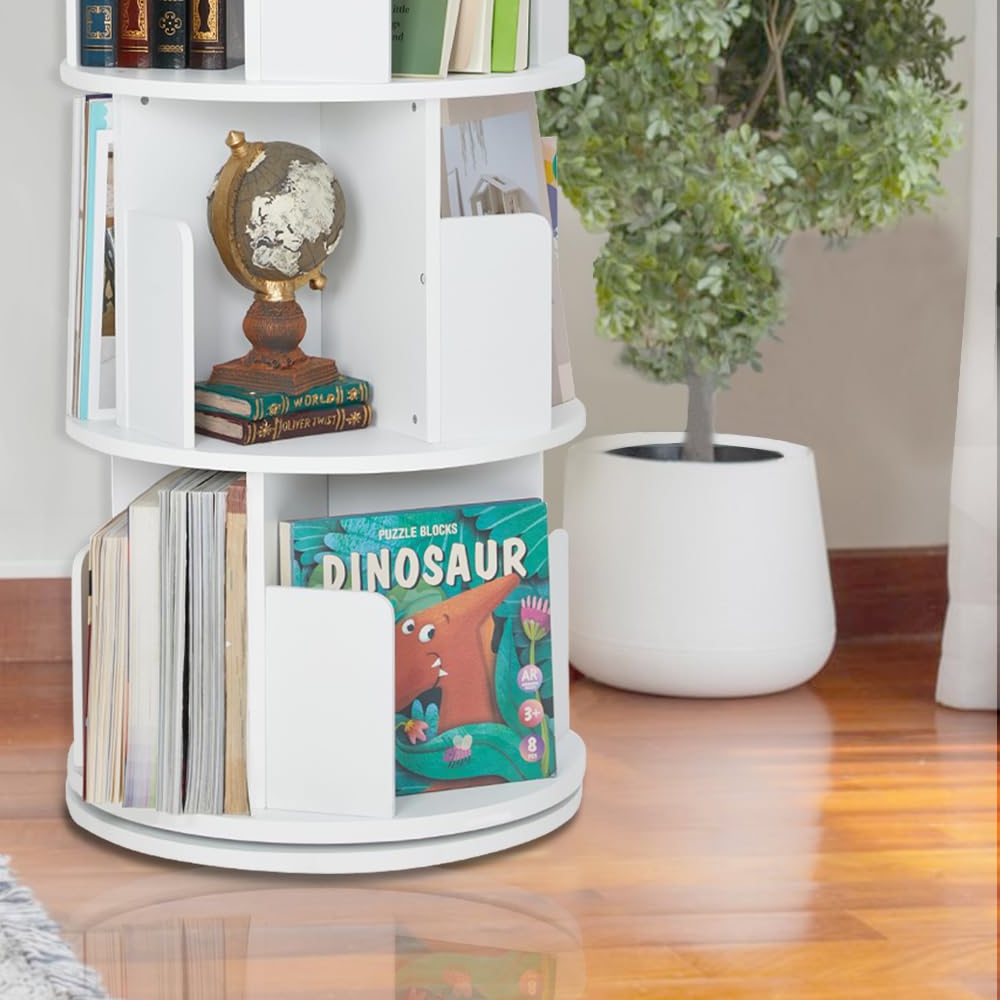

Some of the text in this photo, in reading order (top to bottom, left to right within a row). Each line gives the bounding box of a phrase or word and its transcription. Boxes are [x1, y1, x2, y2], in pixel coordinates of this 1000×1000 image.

[391, 4, 410, 14] ittle
[293, 393, 336, 408] WORLD
[282, 418, 311, 432] OLIVER
[378, 522, 458, 541] PUZZLE BLOCKS
[322, 537, 527, 592] DINOSAUR
[521, 668, 538, 681] AR
[523, 706, 541, 721] 3+
[527, 736, 538, 752] 8
